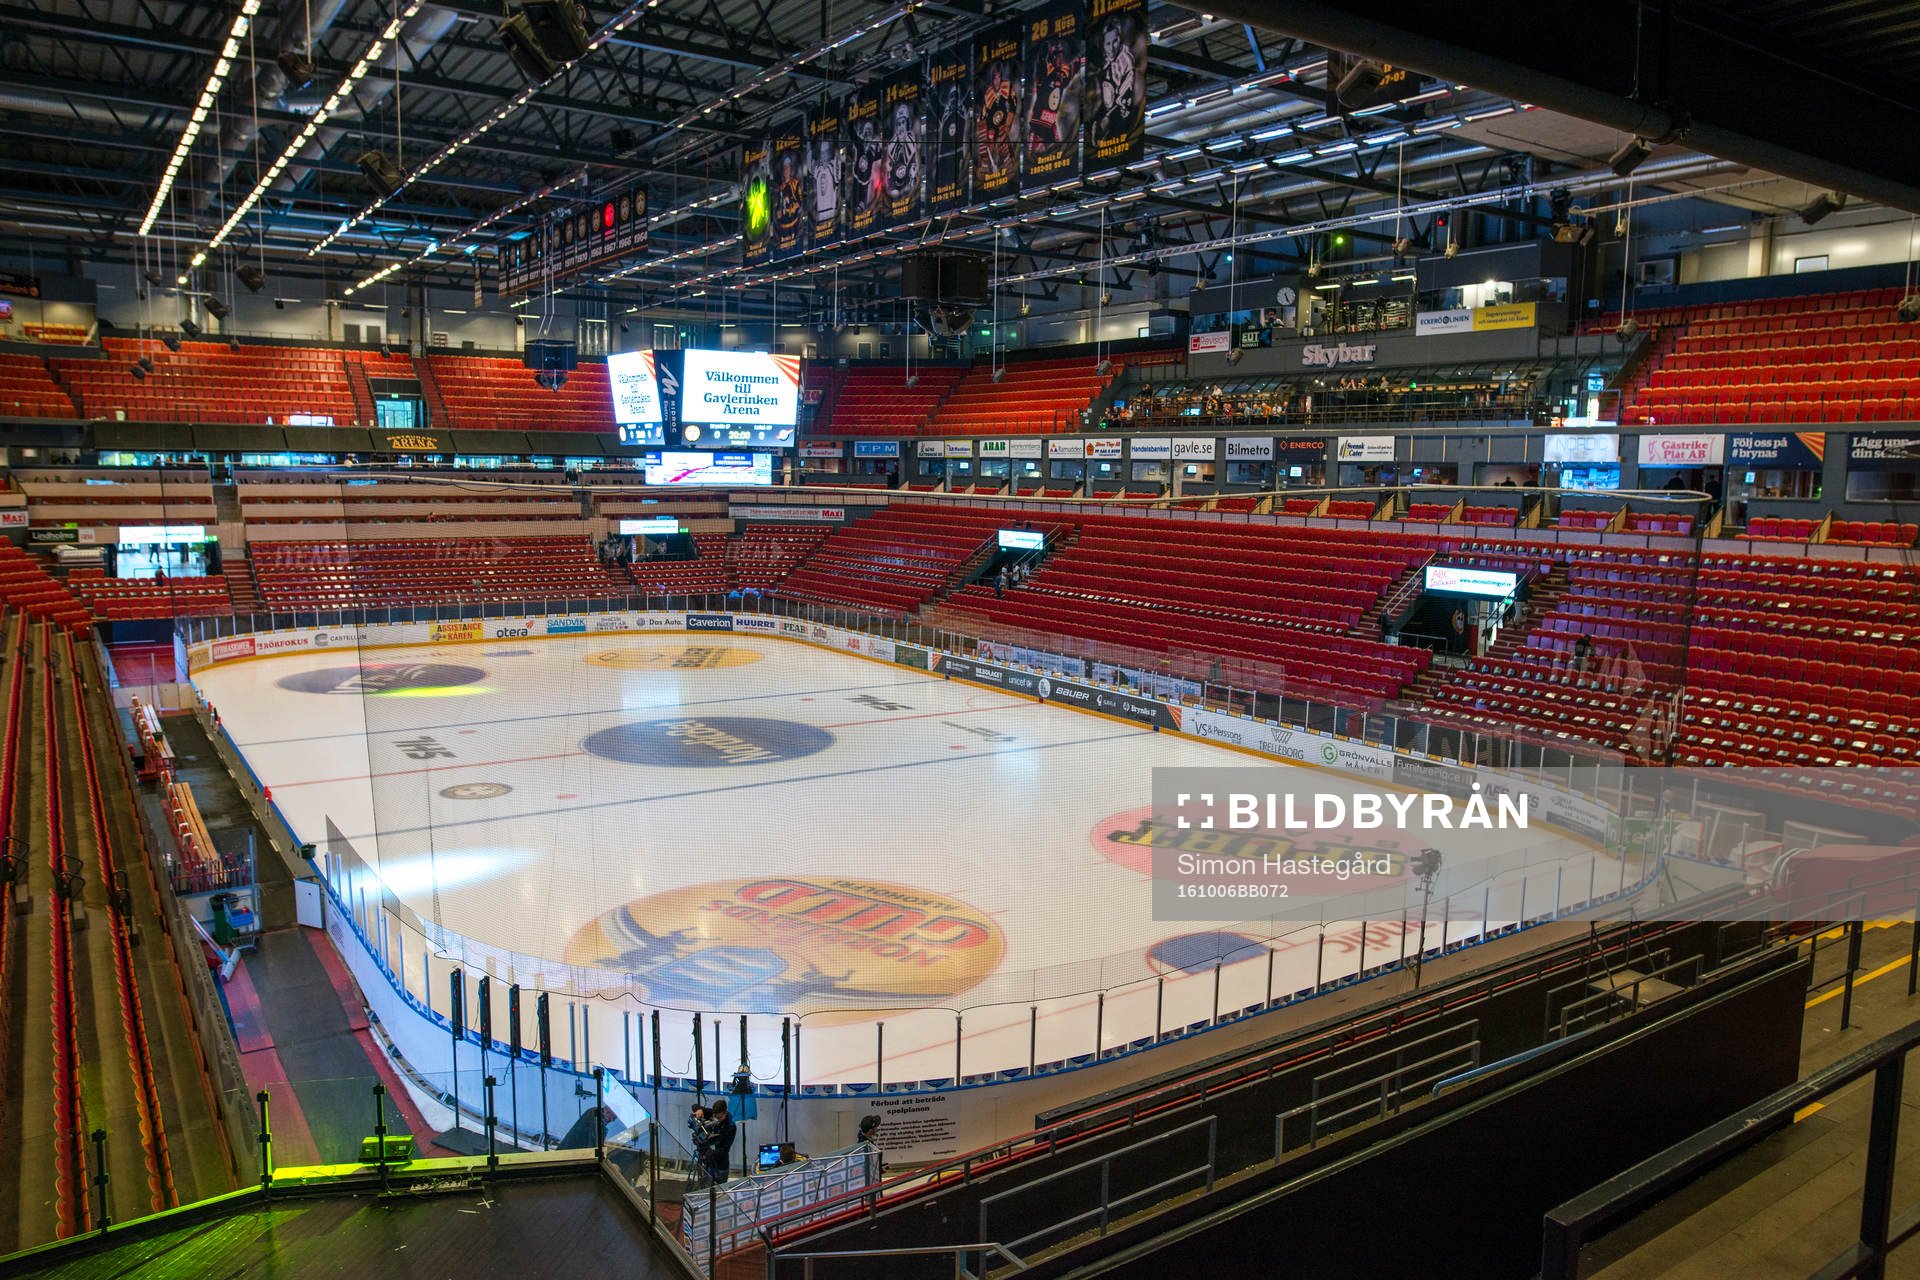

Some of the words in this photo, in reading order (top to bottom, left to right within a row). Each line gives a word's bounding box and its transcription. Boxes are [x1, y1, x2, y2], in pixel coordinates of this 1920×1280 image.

[1031, 18, 1048, 42] 26
[1302, 342, 1376, 369] Skybar
[705, 371, 780, 386] Välkommen
[734, 383, 752, 395] till
[703, 392, 779, 406] Gavlerinken
[723, 404, 760, 416] Arena
[392, 438, 438, 449] ARENA
[1131, 444, 1170, 454] Handelsbanken
[1174, 440, 1213, 457] gavle.se
[1228, 441, 1270, 455] Bilmetro
[1289, 441, 1325, 450] ENERCO
[1347, 442, 1365, 450] Svensk
[1661, 440, 1708, 450] Gästrike
[1732, 437, 1751, 449] Följ
[1753, 440, 1770, 448] oss
[1771, 437, 1788, 450] på
[1852, 436, 1882, 450] Lägg
[1688, 450, 1706, 459] AB
[1852, 448, 1873, 459] din
[437, 622, 481, 632] ASSISTANCE
[547, 617, 586, 628] SANDVIK
[689, 616, 731, 628] Caverion
[736, 619, 775, 629] HUURRE
[496, 627, 528, 642] otera
[1259, 740, 1304, 760] TRELLEBORG
[1339, 749, 1392, 768] GRÖNVALLS
[1345, 759, 1384, 777] MÅLERI
[734, 880, 990, 950] GULD
[871, 1099, 899, 1108] Förbud
[901, 1098, 913, 1106] att
[915, 1095, 945, 1105] beträda
[886, 1106, 930, 1116] spelplanen
